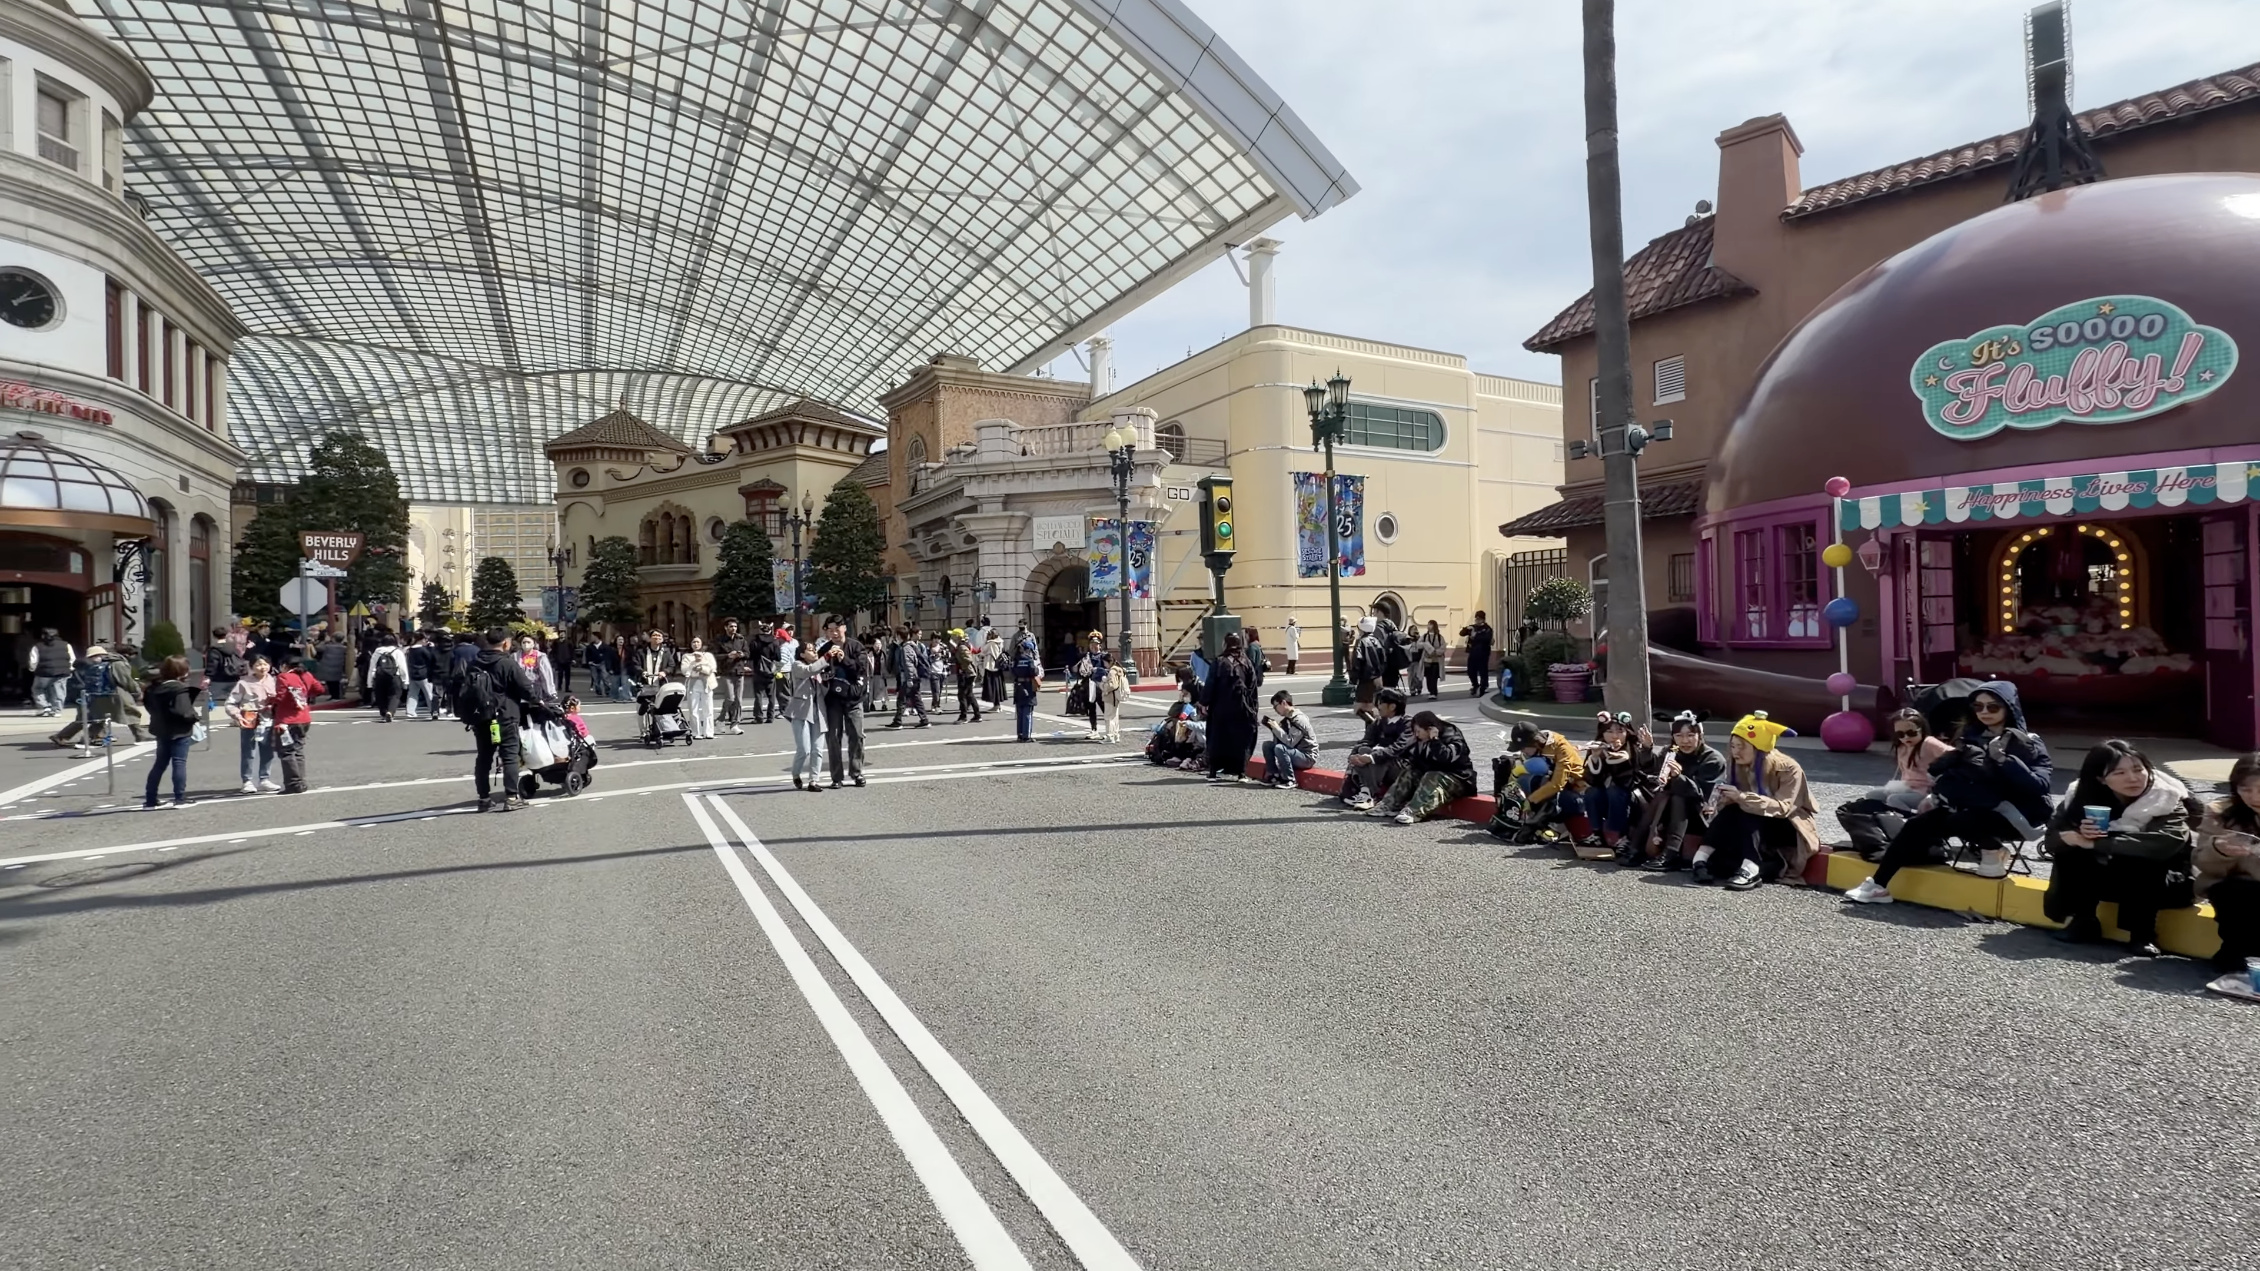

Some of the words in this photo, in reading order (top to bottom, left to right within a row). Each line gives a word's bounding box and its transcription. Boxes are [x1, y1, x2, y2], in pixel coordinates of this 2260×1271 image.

[1970, 334, 2021, 366] It's
[1940, 331, 2205, 425] Fluffy!
[1167, 487, 1190, 501] GO
[1957, 487, 2076, 513] Happiness
[2080, 474, 2148, 498] Lives
[2154, 471, 2217, 495] Here
[305, 535, 357, 548] BEVERLY
[1036, 529, 1081, 540] SPECIALTY
[314, 549, 349, 560] HILLS
